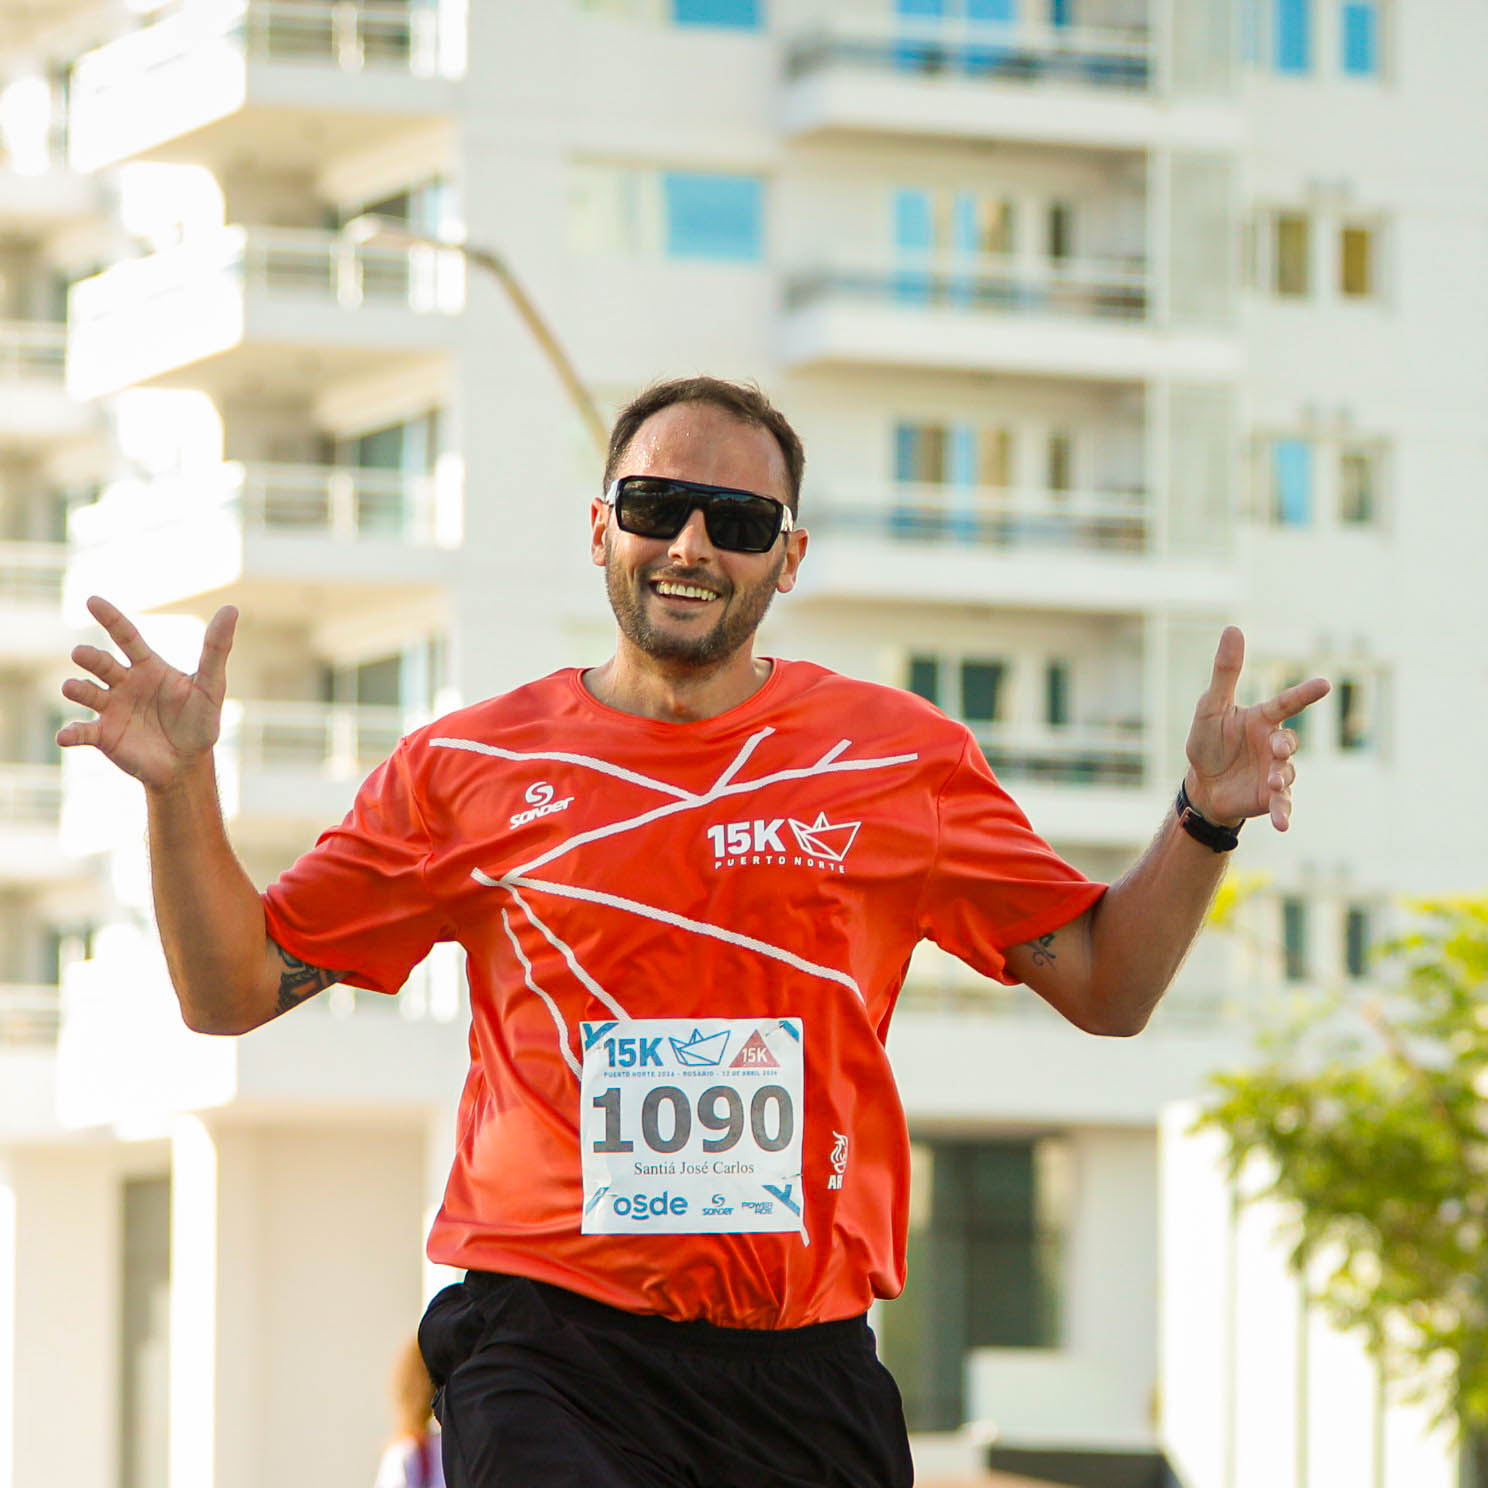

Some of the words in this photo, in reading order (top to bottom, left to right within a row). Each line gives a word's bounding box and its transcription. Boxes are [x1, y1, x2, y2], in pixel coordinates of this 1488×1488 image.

[707, 818, 786, 858] 15K
[715, 856, 786, 870] PUERTO
[794, 856, 845, 874] NORTE
[603, 1037, 664, 1067] 15K
[742, 1047, 767, 1063] 15K
[592, 1085, 794, 1154] 1090
[633, 1160, 676, 1175] Santiá
[679, 1160, 710, 1175] José
[712, 1160, 755, 1175] Carlos
[613, 1191, 689, 1216] osde
